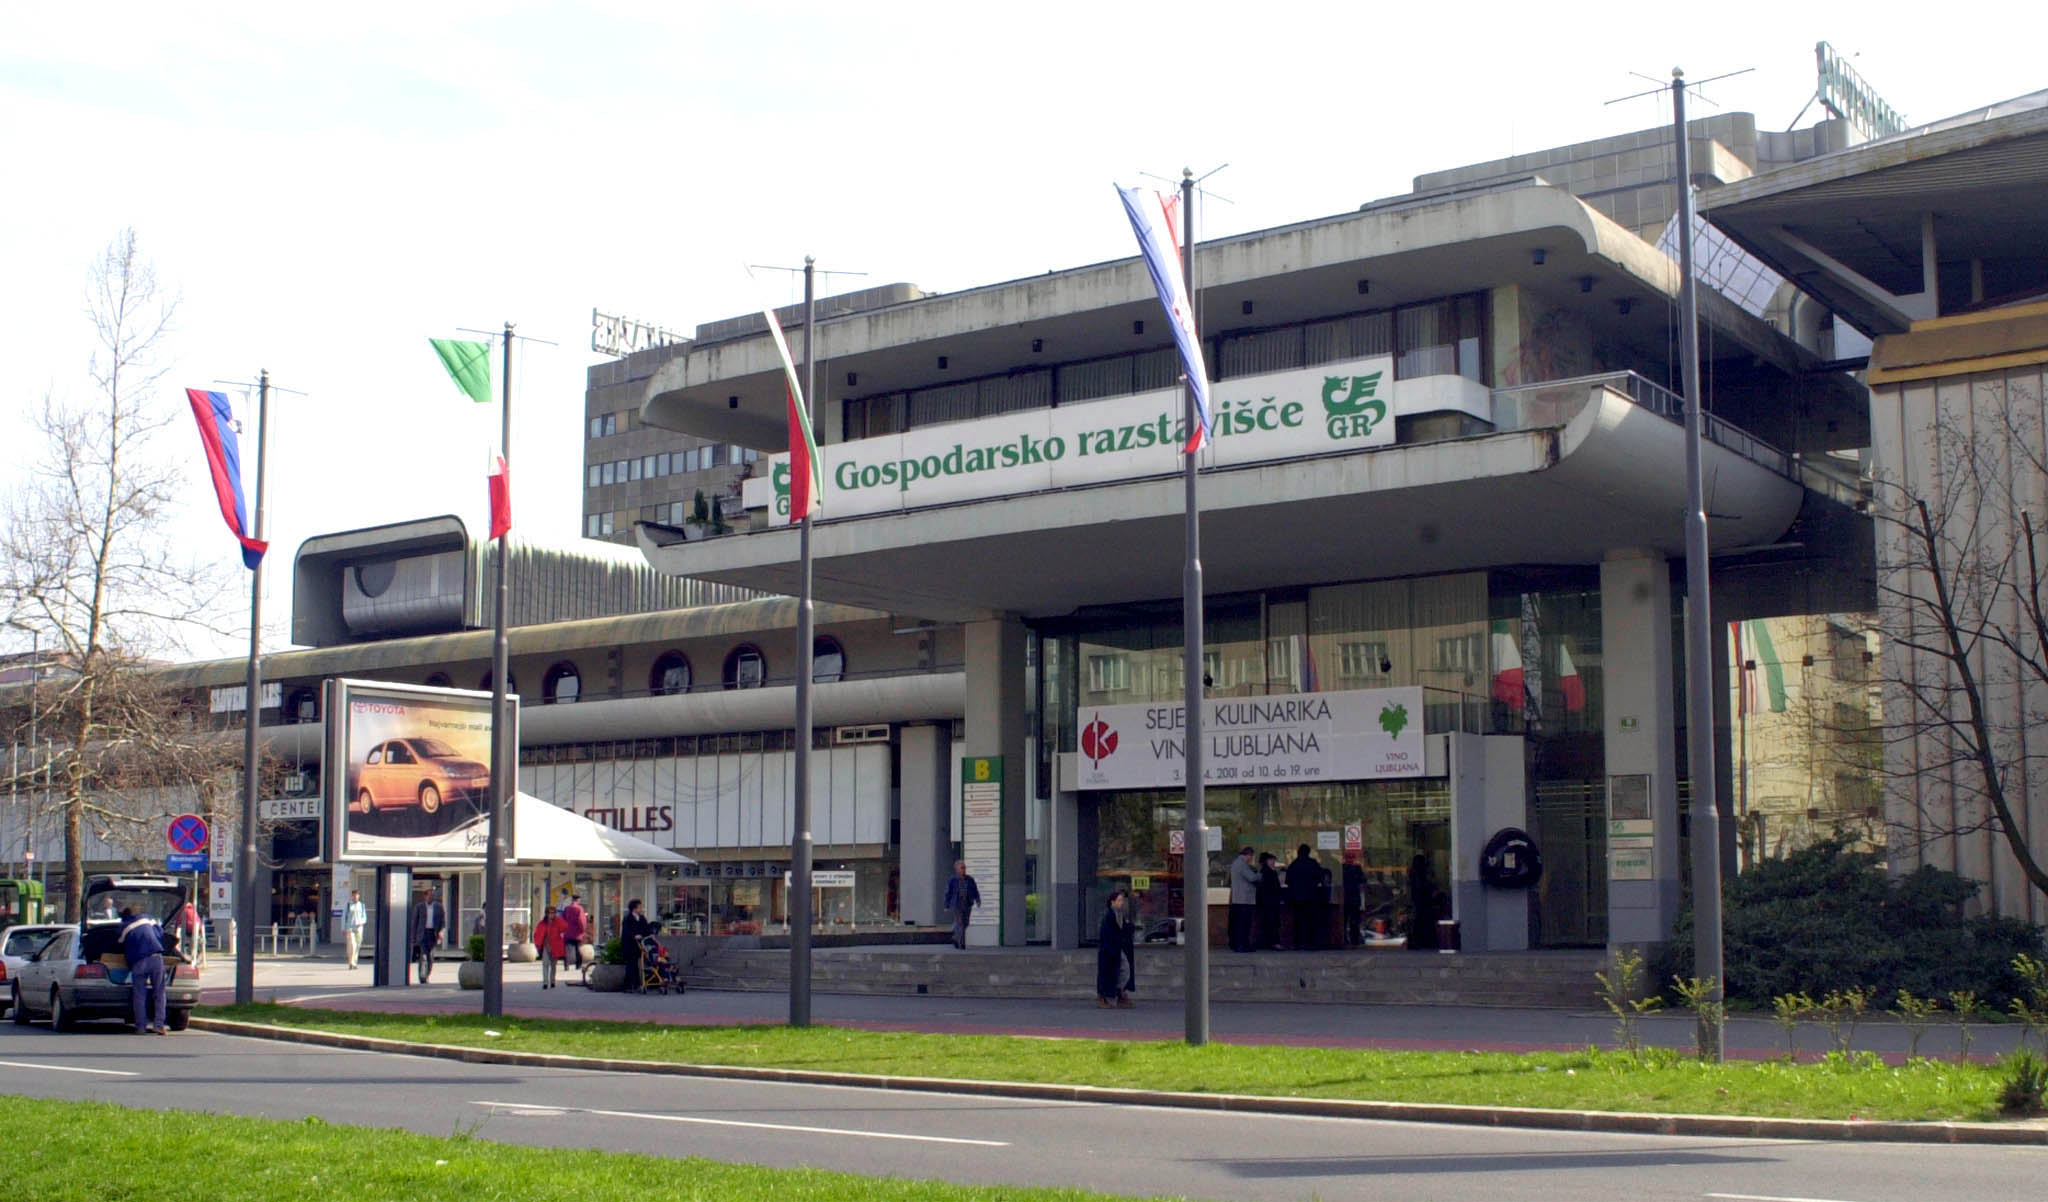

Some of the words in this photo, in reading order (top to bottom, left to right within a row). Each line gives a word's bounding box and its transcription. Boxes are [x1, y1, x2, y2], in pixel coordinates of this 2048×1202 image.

[1328, 414, 1372, 440] GR
[835, 433, 1065, 492] Gospodarsko
[776, 496, 790, 516] G
[369, 703, 405, 715] TOYOTA
[1215, 699, 1332, 726] KULINARIKA
[1151, 738, 1186, 760] VIN
[1213, 731, 1320, 758] LJUBLJANA
[1386, 752, 1408, 761] VINO
[975, 760, 990, 780] B
[1217, 767, 1238, 779] 2001
[1242, 763, 1254, 778] od
[1274, 763, 1286, 777] do
[1304, 767, 1320, 776] ure
[1375, 762, 1420, 773] LJUBLJANA
[270, 801, 320, 815] CENTE
